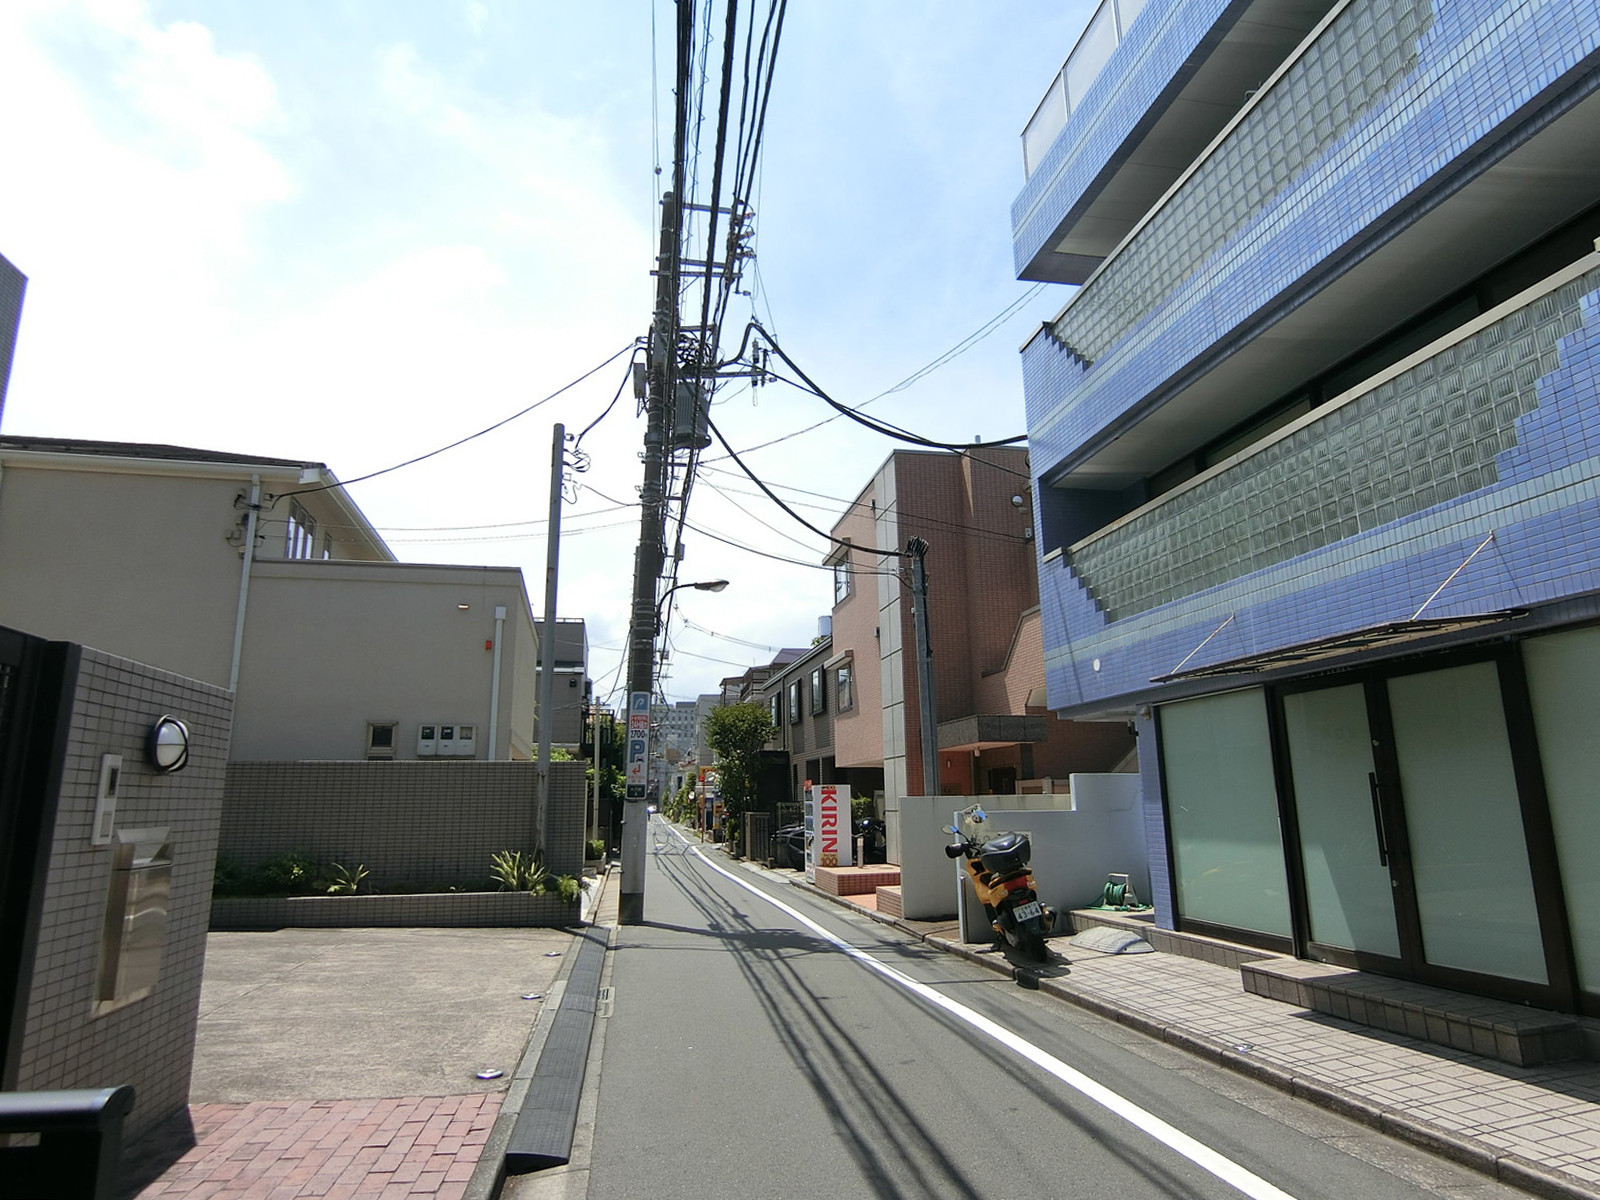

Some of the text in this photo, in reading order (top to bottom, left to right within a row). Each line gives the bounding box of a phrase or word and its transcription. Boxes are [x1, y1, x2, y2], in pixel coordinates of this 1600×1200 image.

[629, 740, 645, 763] P
[821, 789, 838, 853] KIRIN
[820, 857, 838, 867] 100
